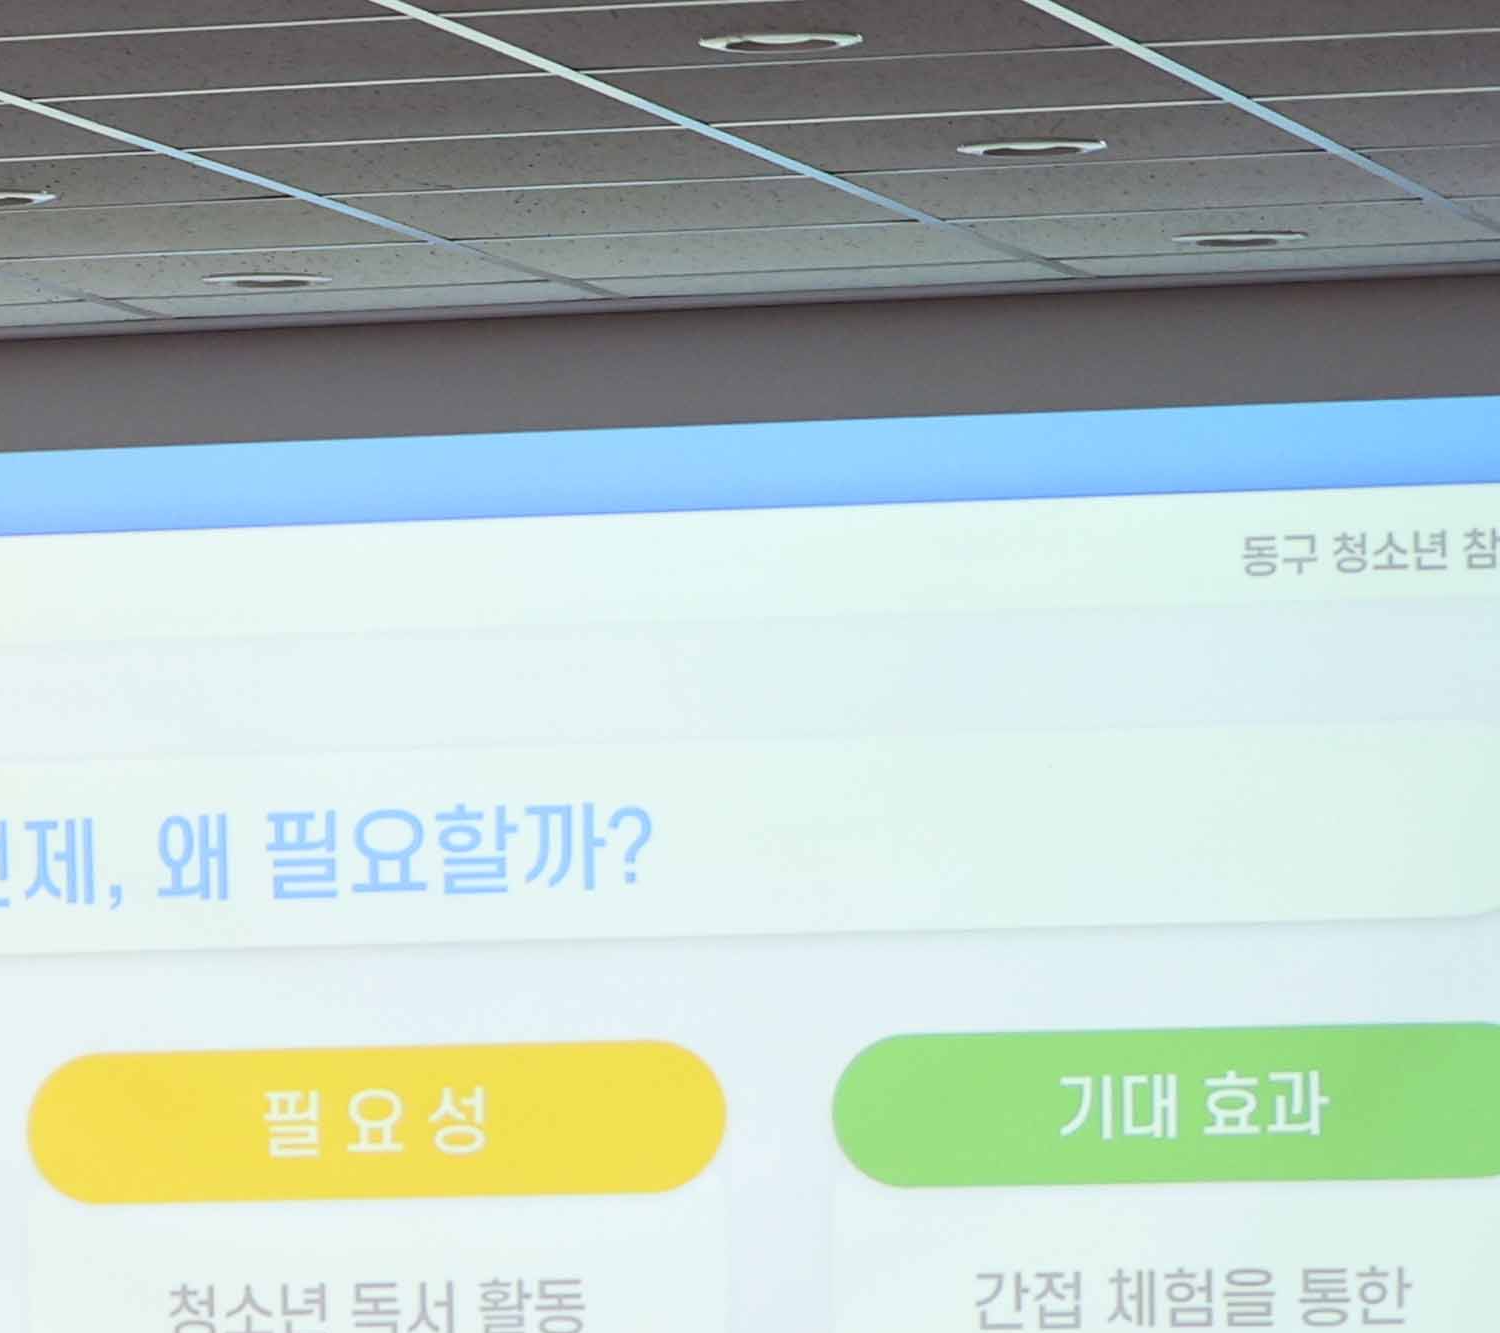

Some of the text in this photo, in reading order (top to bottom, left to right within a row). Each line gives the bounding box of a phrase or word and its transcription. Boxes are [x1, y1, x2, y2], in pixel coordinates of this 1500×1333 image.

[1242, 533, 1319, 577] 동구
[1333, 528, 1449, 574] 청소년
[156, 813, 229, 902] 왜
[265, 801, 653, 901] 필요할까?
[1059, 1070, 1330, 1141] 기대 효과
[975, 1265, 1413, 1332] 간접 체험을 통한
